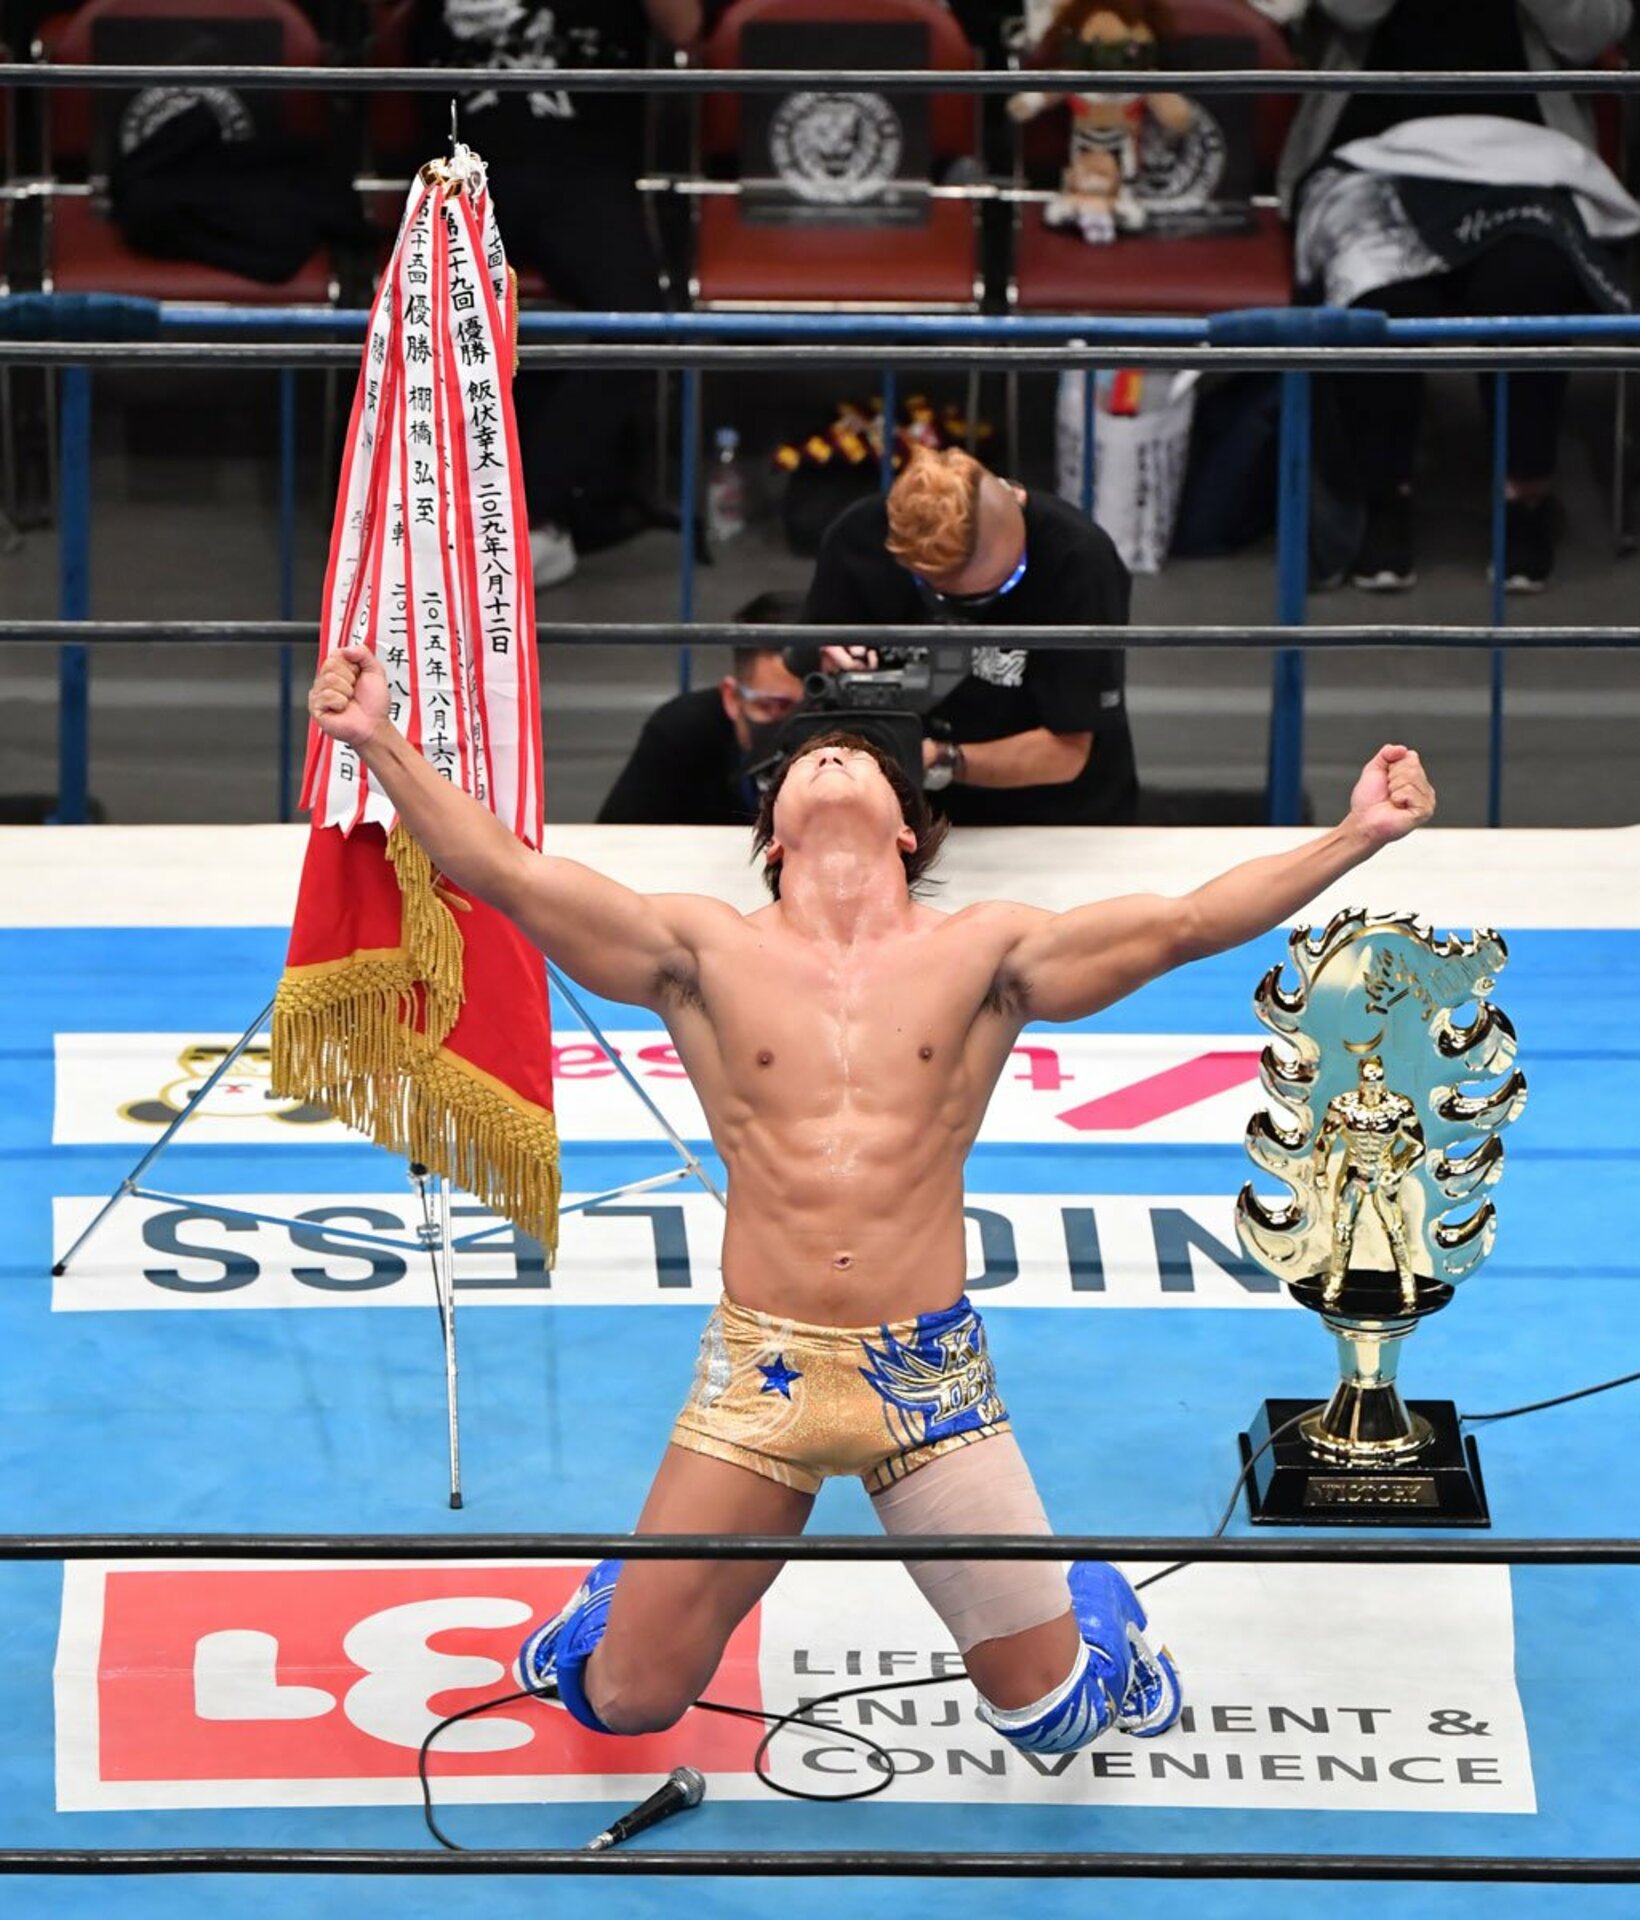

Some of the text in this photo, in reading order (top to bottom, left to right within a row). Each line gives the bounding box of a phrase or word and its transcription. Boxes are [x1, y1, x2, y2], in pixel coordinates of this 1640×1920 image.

[793, 1649, 964, 1677] LIFE
[797, 1696, 1493, 1737] ENJENT &
[801, 1746, 1503, 1785] CONVENIENCE
